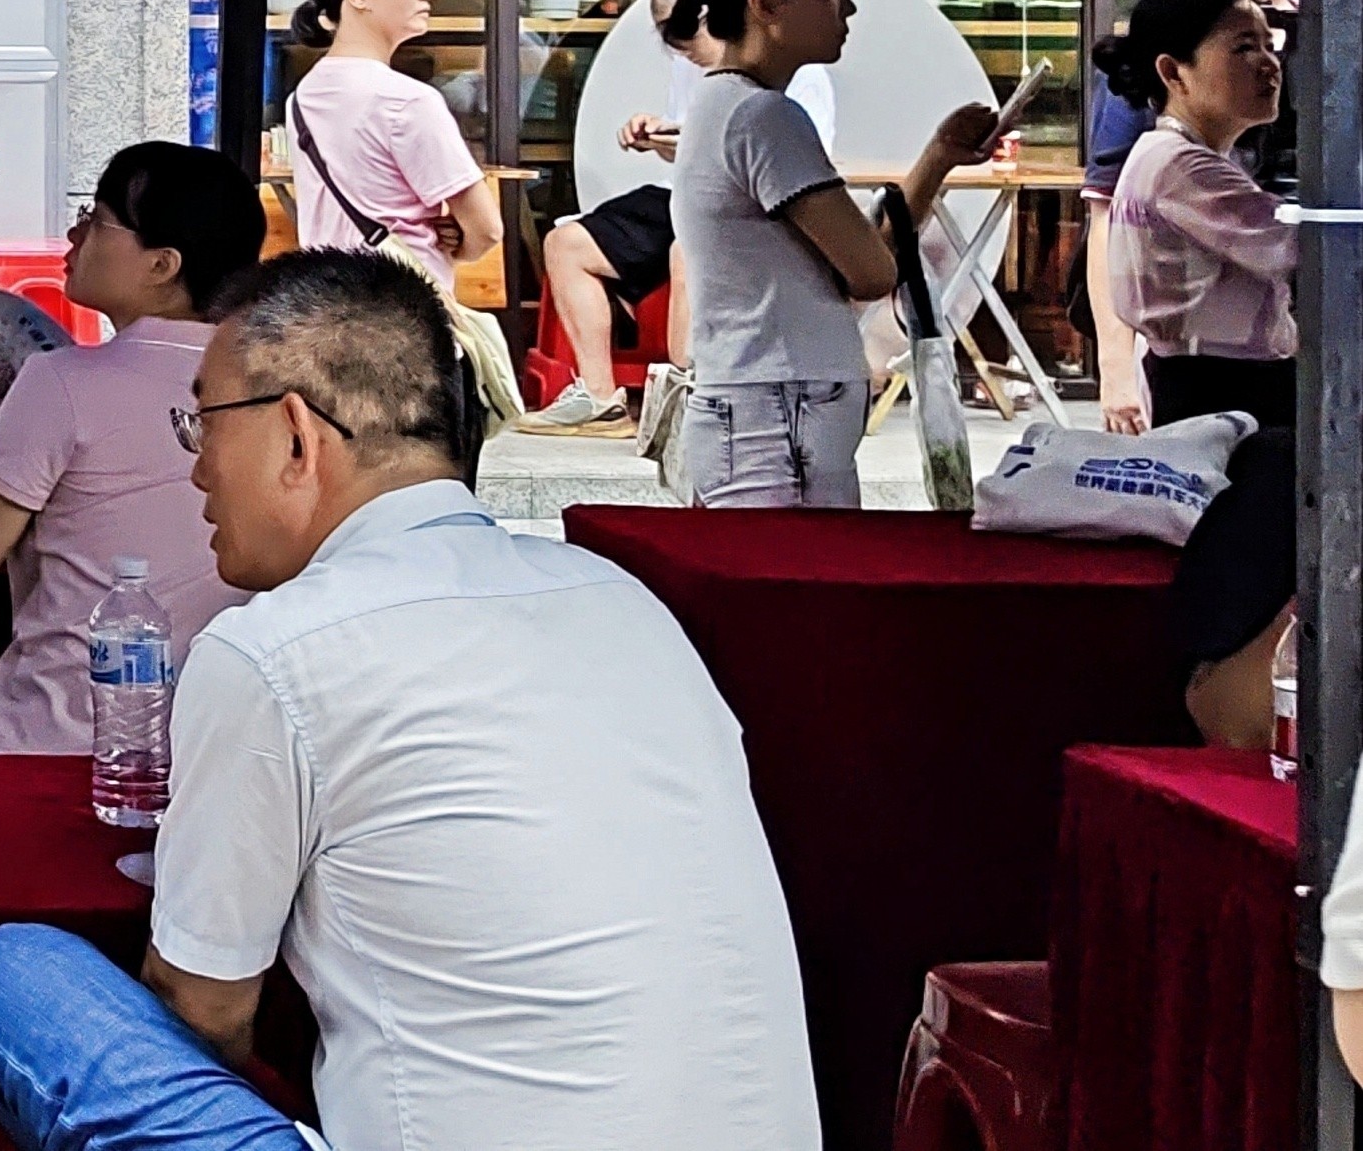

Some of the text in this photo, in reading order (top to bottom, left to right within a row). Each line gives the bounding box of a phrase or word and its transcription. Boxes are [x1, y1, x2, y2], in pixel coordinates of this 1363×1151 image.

[1074, 472, 1211, 512] 世界新能源汽车大
